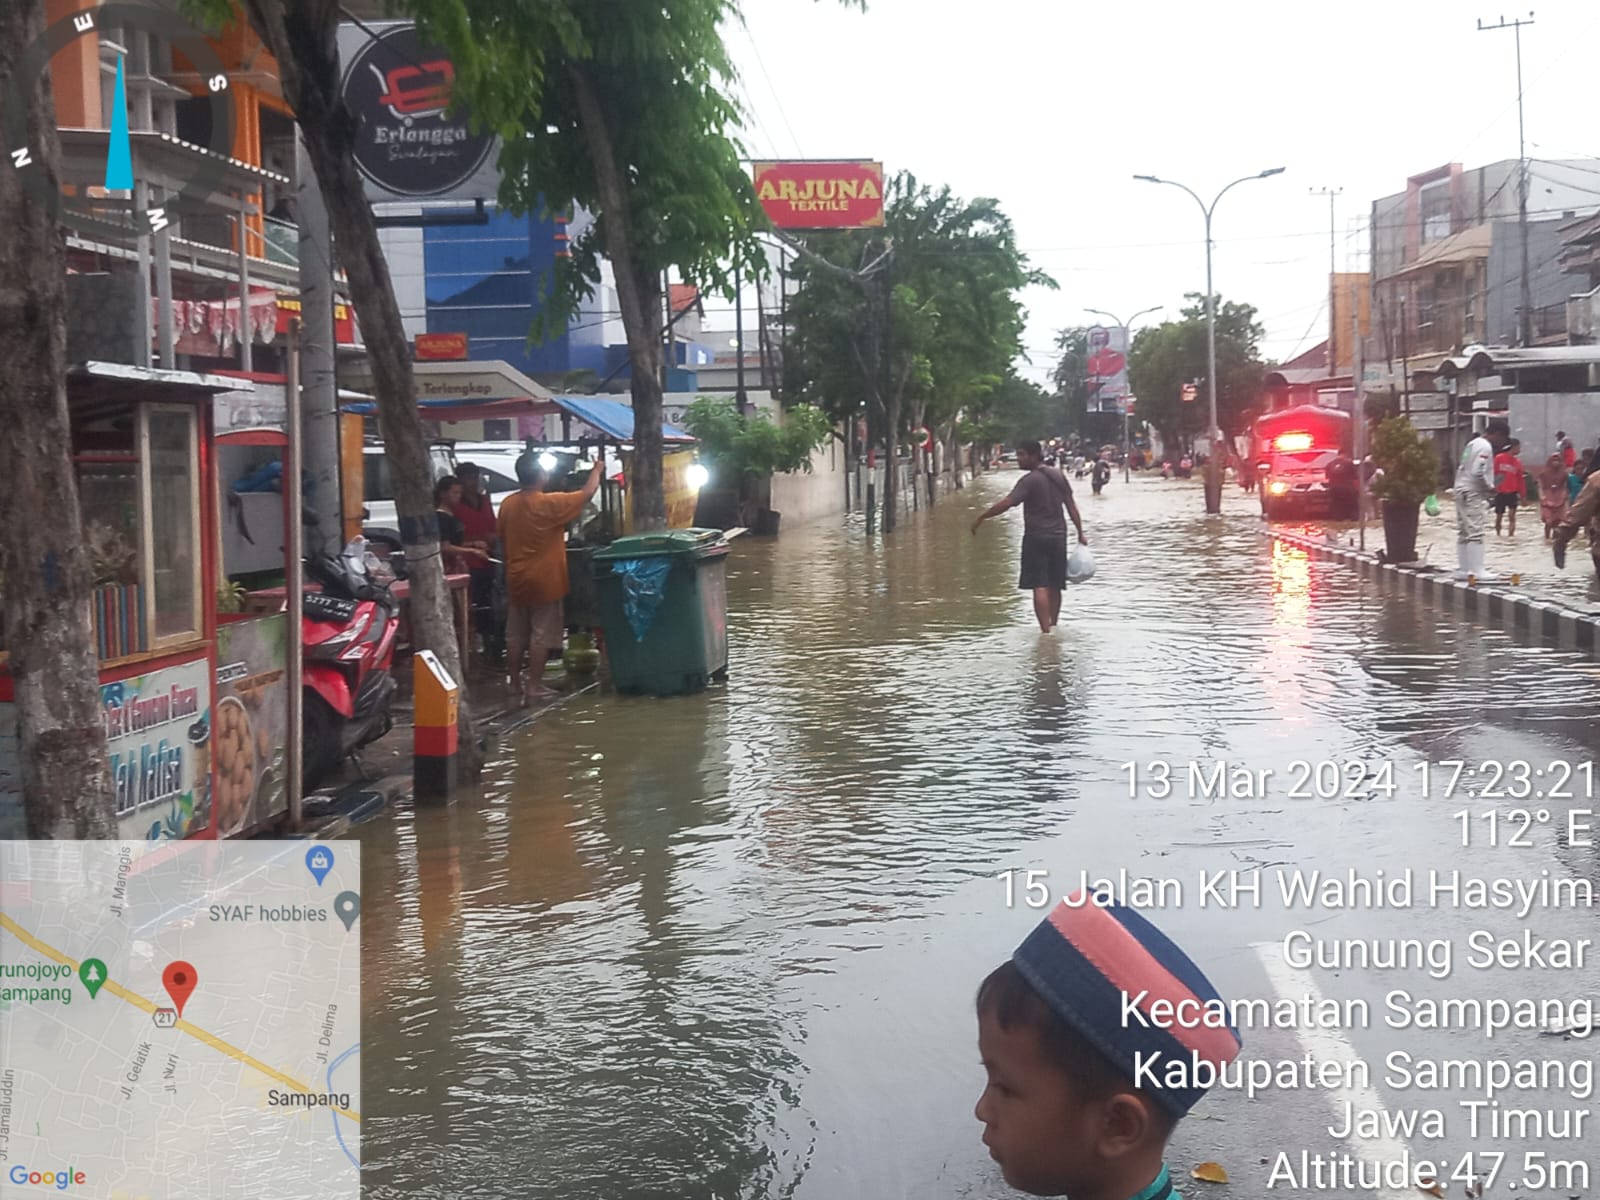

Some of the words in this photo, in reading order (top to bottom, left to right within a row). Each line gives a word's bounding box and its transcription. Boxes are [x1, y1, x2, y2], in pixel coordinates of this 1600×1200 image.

[374, 126, 467, 145] Erlangga
[759, 179, 880, 200] ARJUNA
[790, 199, 849, 211] TEXTILE
